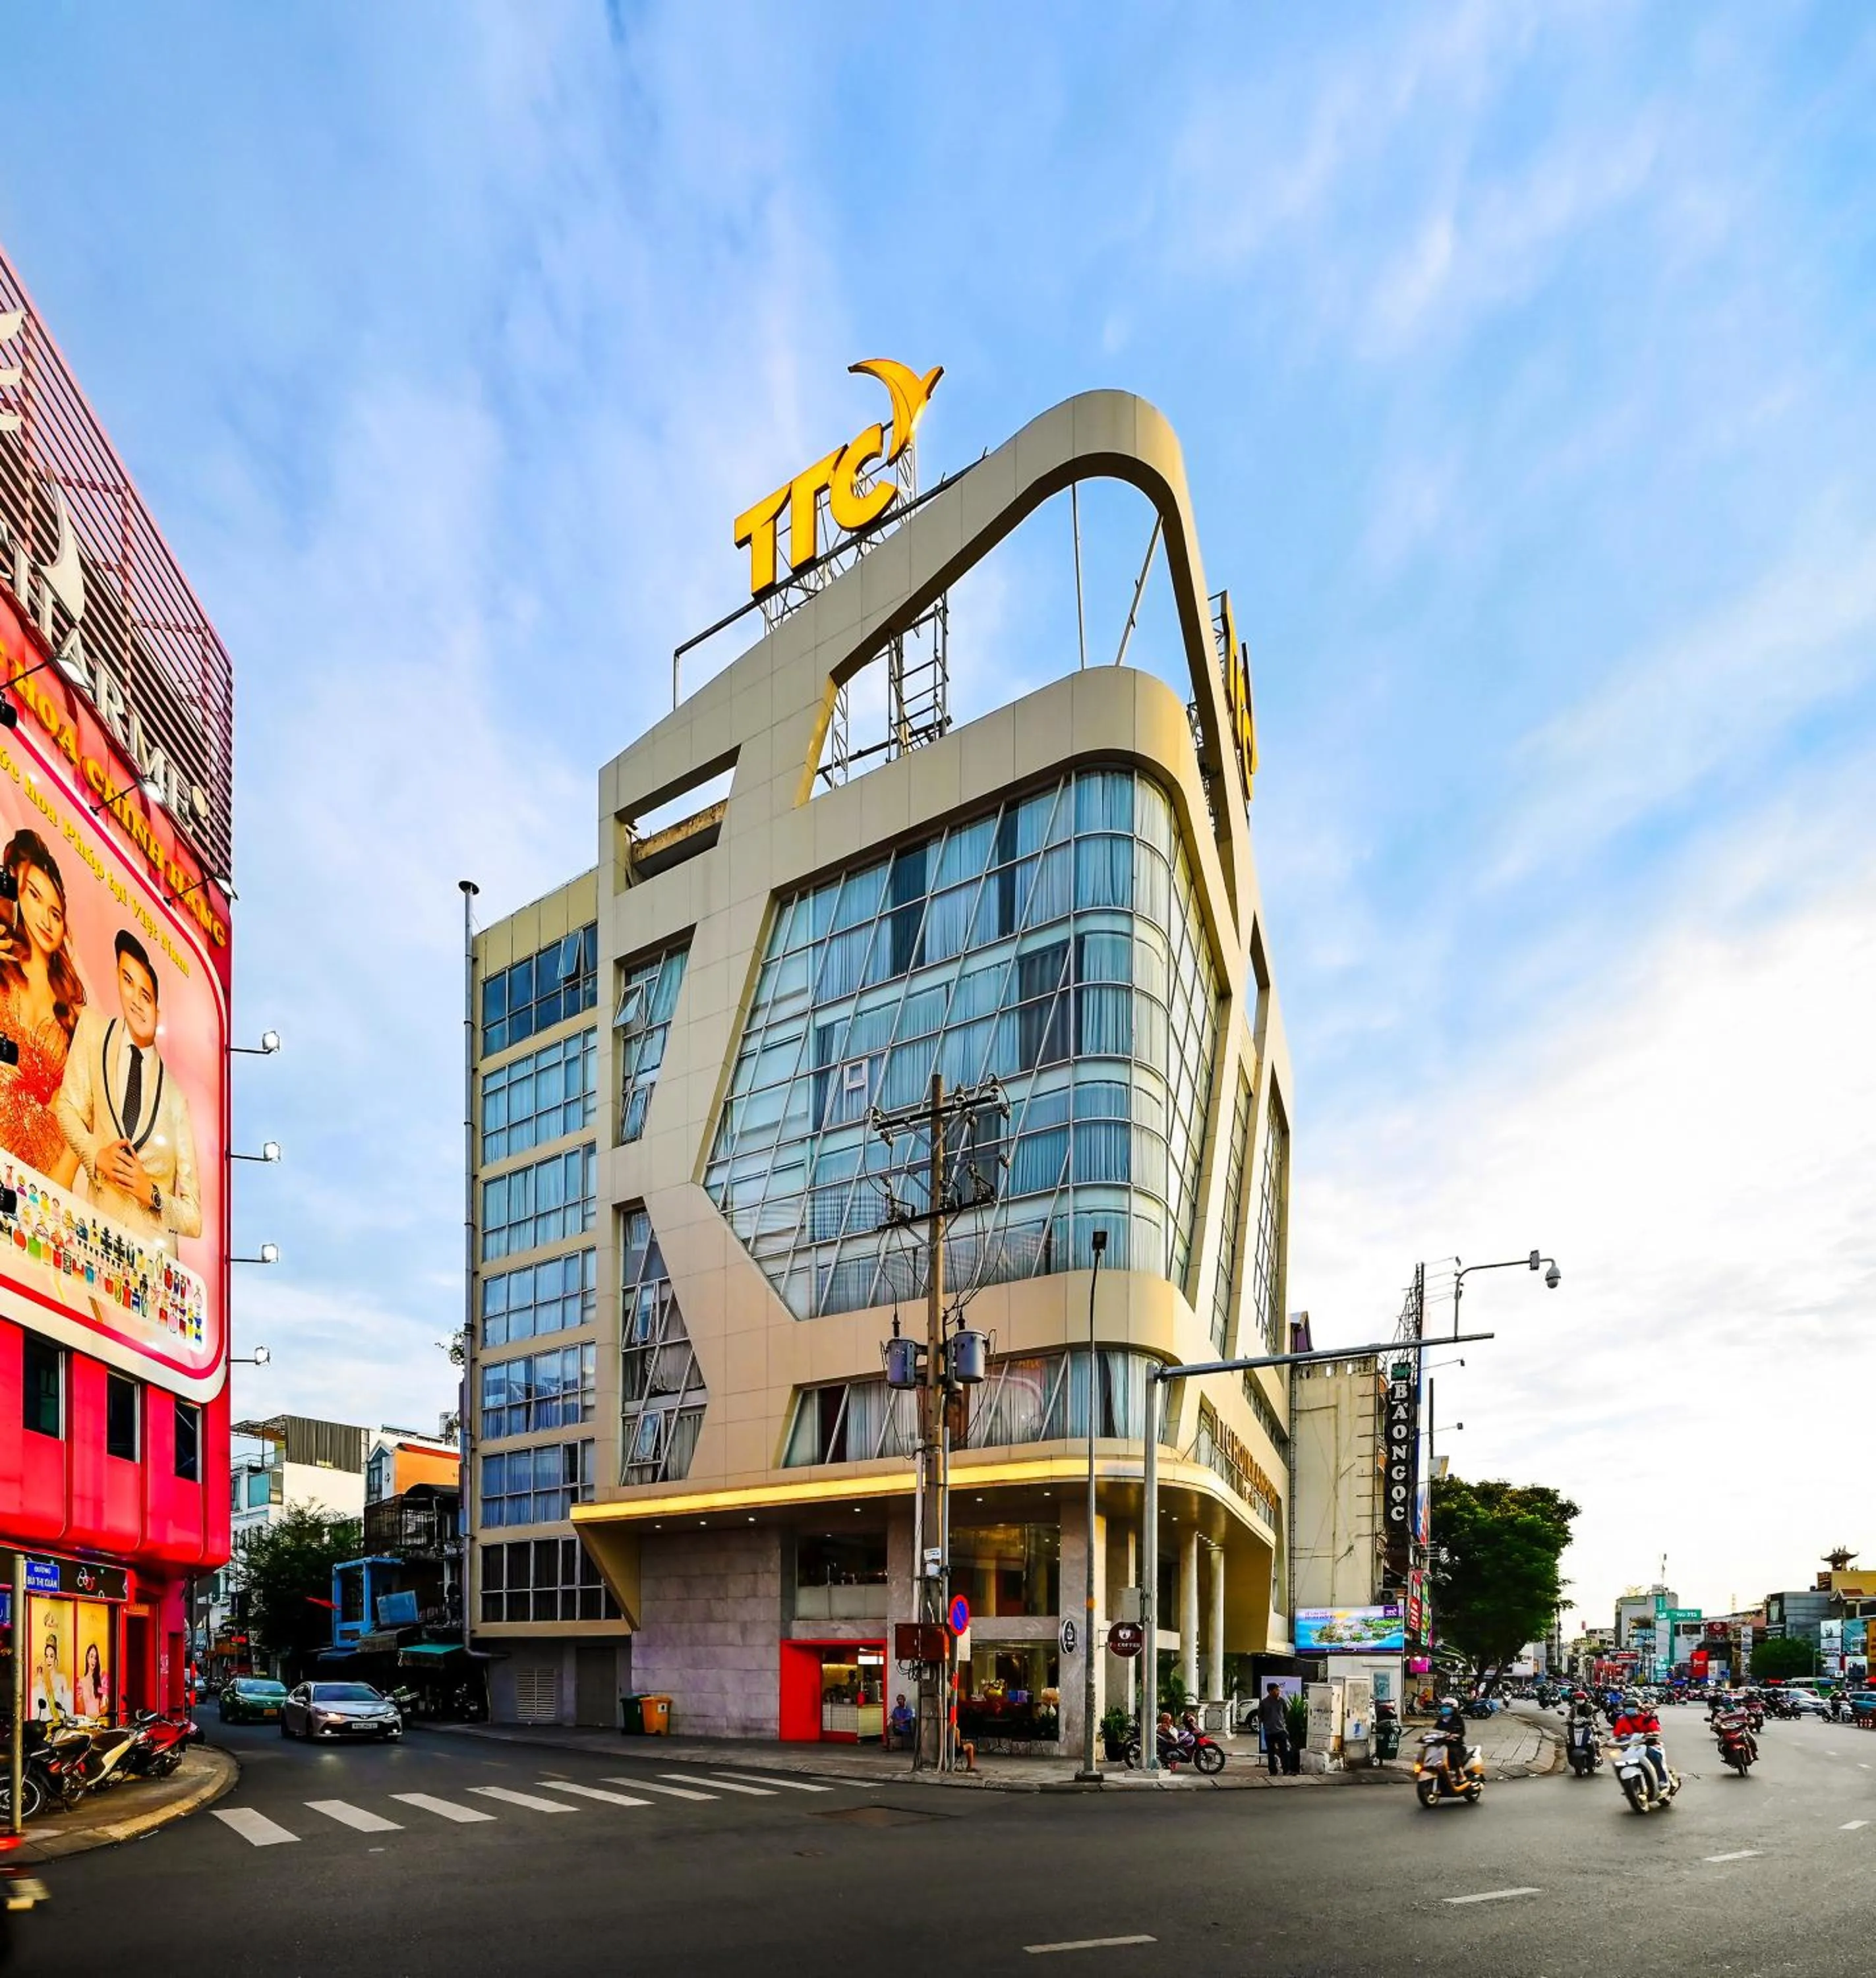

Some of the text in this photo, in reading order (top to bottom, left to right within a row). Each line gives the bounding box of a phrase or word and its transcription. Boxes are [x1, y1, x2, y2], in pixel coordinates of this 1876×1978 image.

[734, 423, 898, 595] TTC
[13, 658, 79, 765] HOA
[83, 758, 164, 870] CHÍNH
[24, 773, 57, 827] hoa
